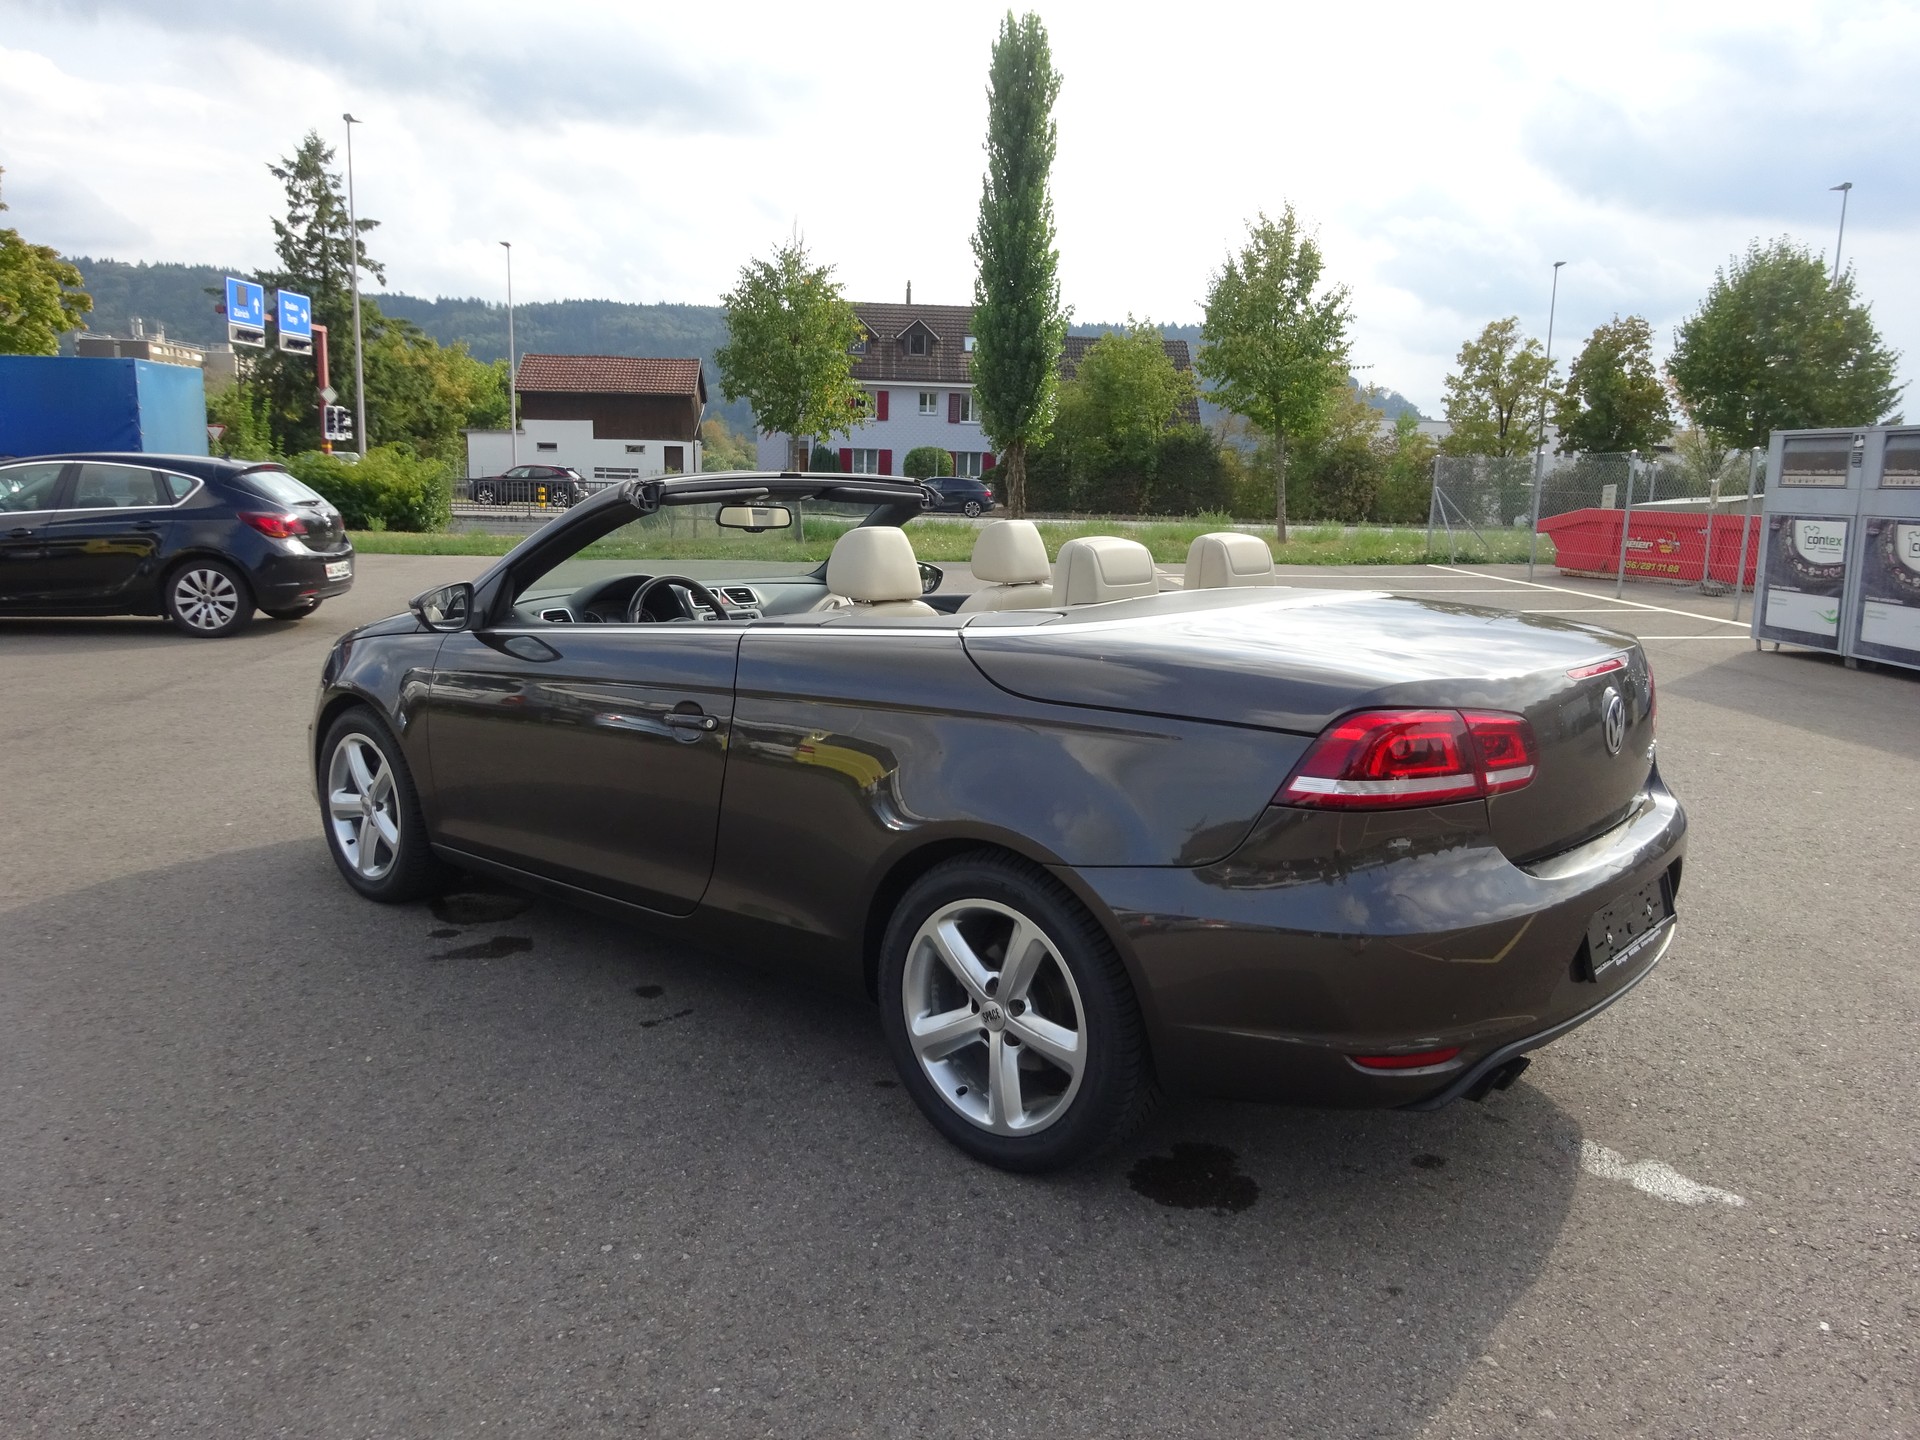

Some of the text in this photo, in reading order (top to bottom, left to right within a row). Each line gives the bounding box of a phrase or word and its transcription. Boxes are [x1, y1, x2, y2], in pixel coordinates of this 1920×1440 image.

[1625, 537, 1653, 549] eier
[1807, 535, 1843, 546] contex
[1624, 560, 1657, 571] 56/281
[982, 1008, 1001, 1023] SPACE
